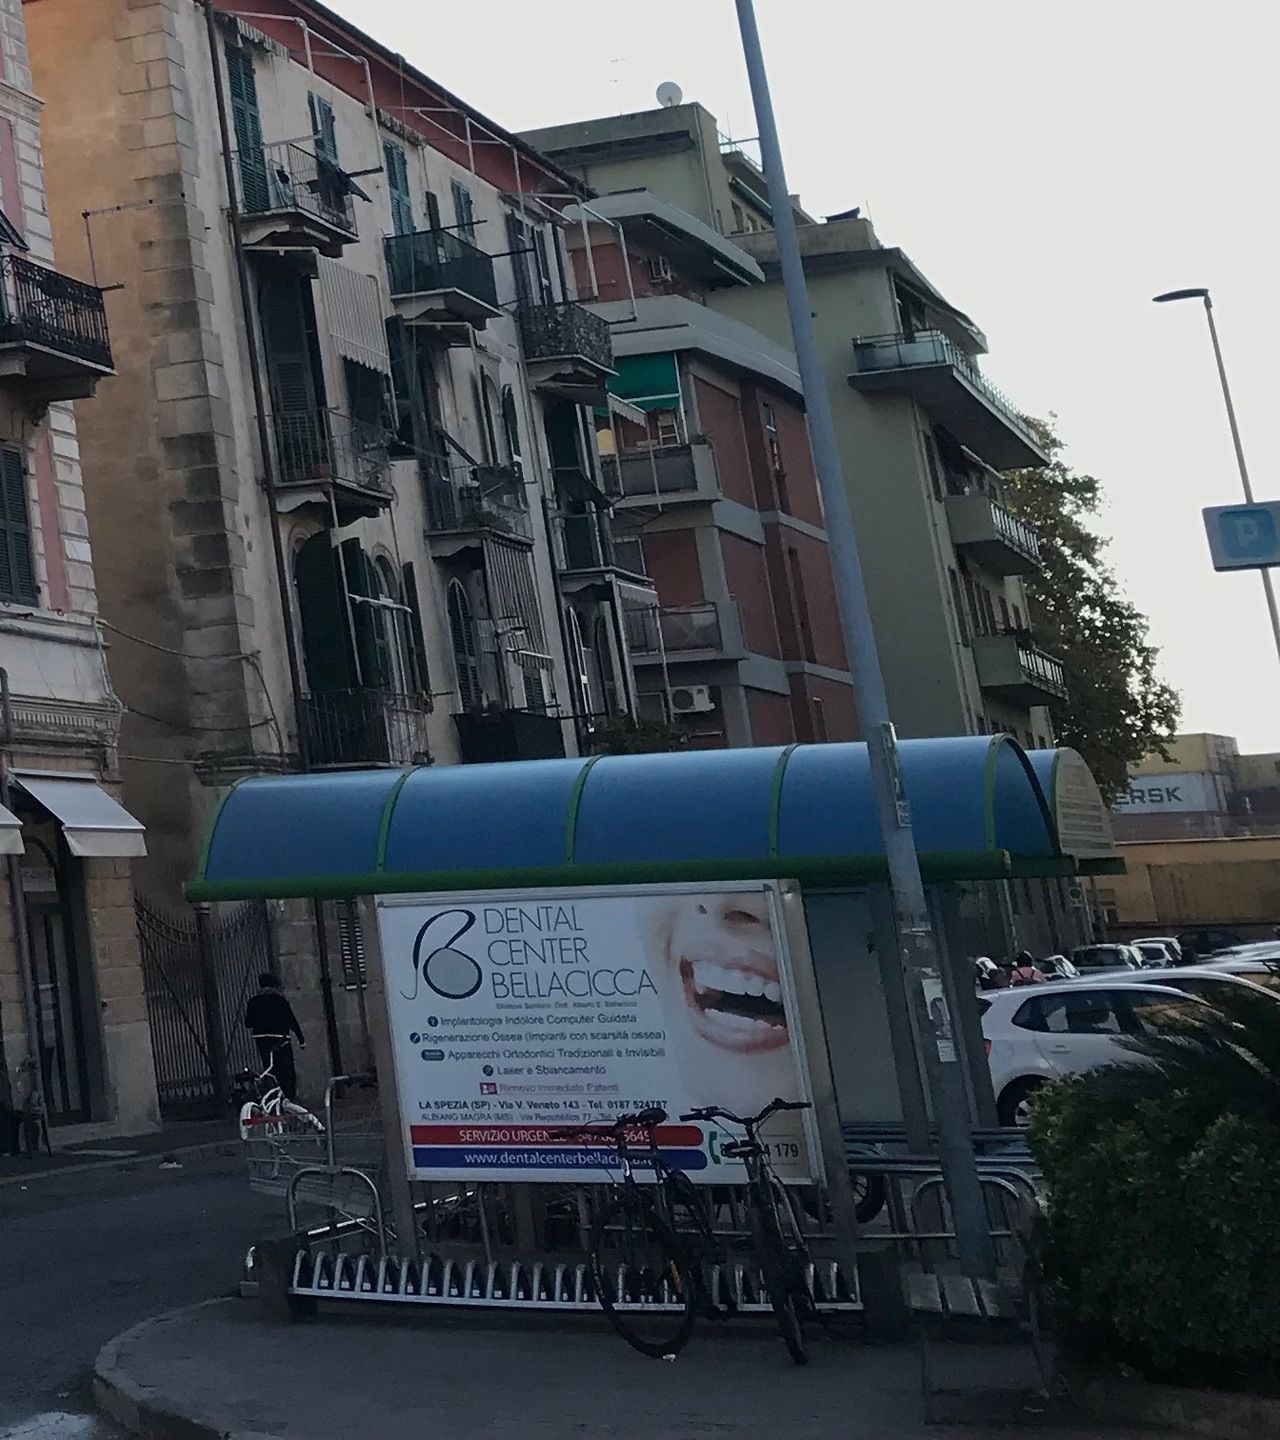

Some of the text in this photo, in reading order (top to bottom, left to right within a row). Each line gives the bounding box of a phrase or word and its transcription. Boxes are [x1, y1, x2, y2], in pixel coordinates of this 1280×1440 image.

[1115, 787, 1183, 805] ERSK
[483, 906, 584, 934] DENTAL
[488, 938, 590, 965] CENTER
[492, 969, 658, 999] BELLACICCA
[440, 1013, 637, 1028] Implantologia Indolore Computer Guidata
[422, 1030, 666, 1044] Rigenerazione Ossea (Impianti con scarsità ossea)
[448, 1050, 500, 1061] Apparecchi
[503, 1049, 554, 1058] Ortodontici
[557, 1048, 614, 1058] Tradizionali
[625, 1048, 665, 1057] Invisibili
[497, 1065, 524, 1075] Laser
[535, 1065, 606, 1075] Sbiancamento
[419, 1101, 431, 1109] LA
[434, 1100, 468, 1109] SPEZIA
[471, 1100, 491, 1111] (SP)
[499, 1100, 513, 1109] Via
[527, 1100, 560, 1109] Veneto
[563, 1100, 579, 1109] 143
[588, 1100, 603, 1109] Tel.
[608, 1100, 629, 1109] 0187
[460, 1129, 509, 1142] SERVIZIO
[511, 1129, 566, 1142] URGEN
[774, 1143, 799, 1157] 179
